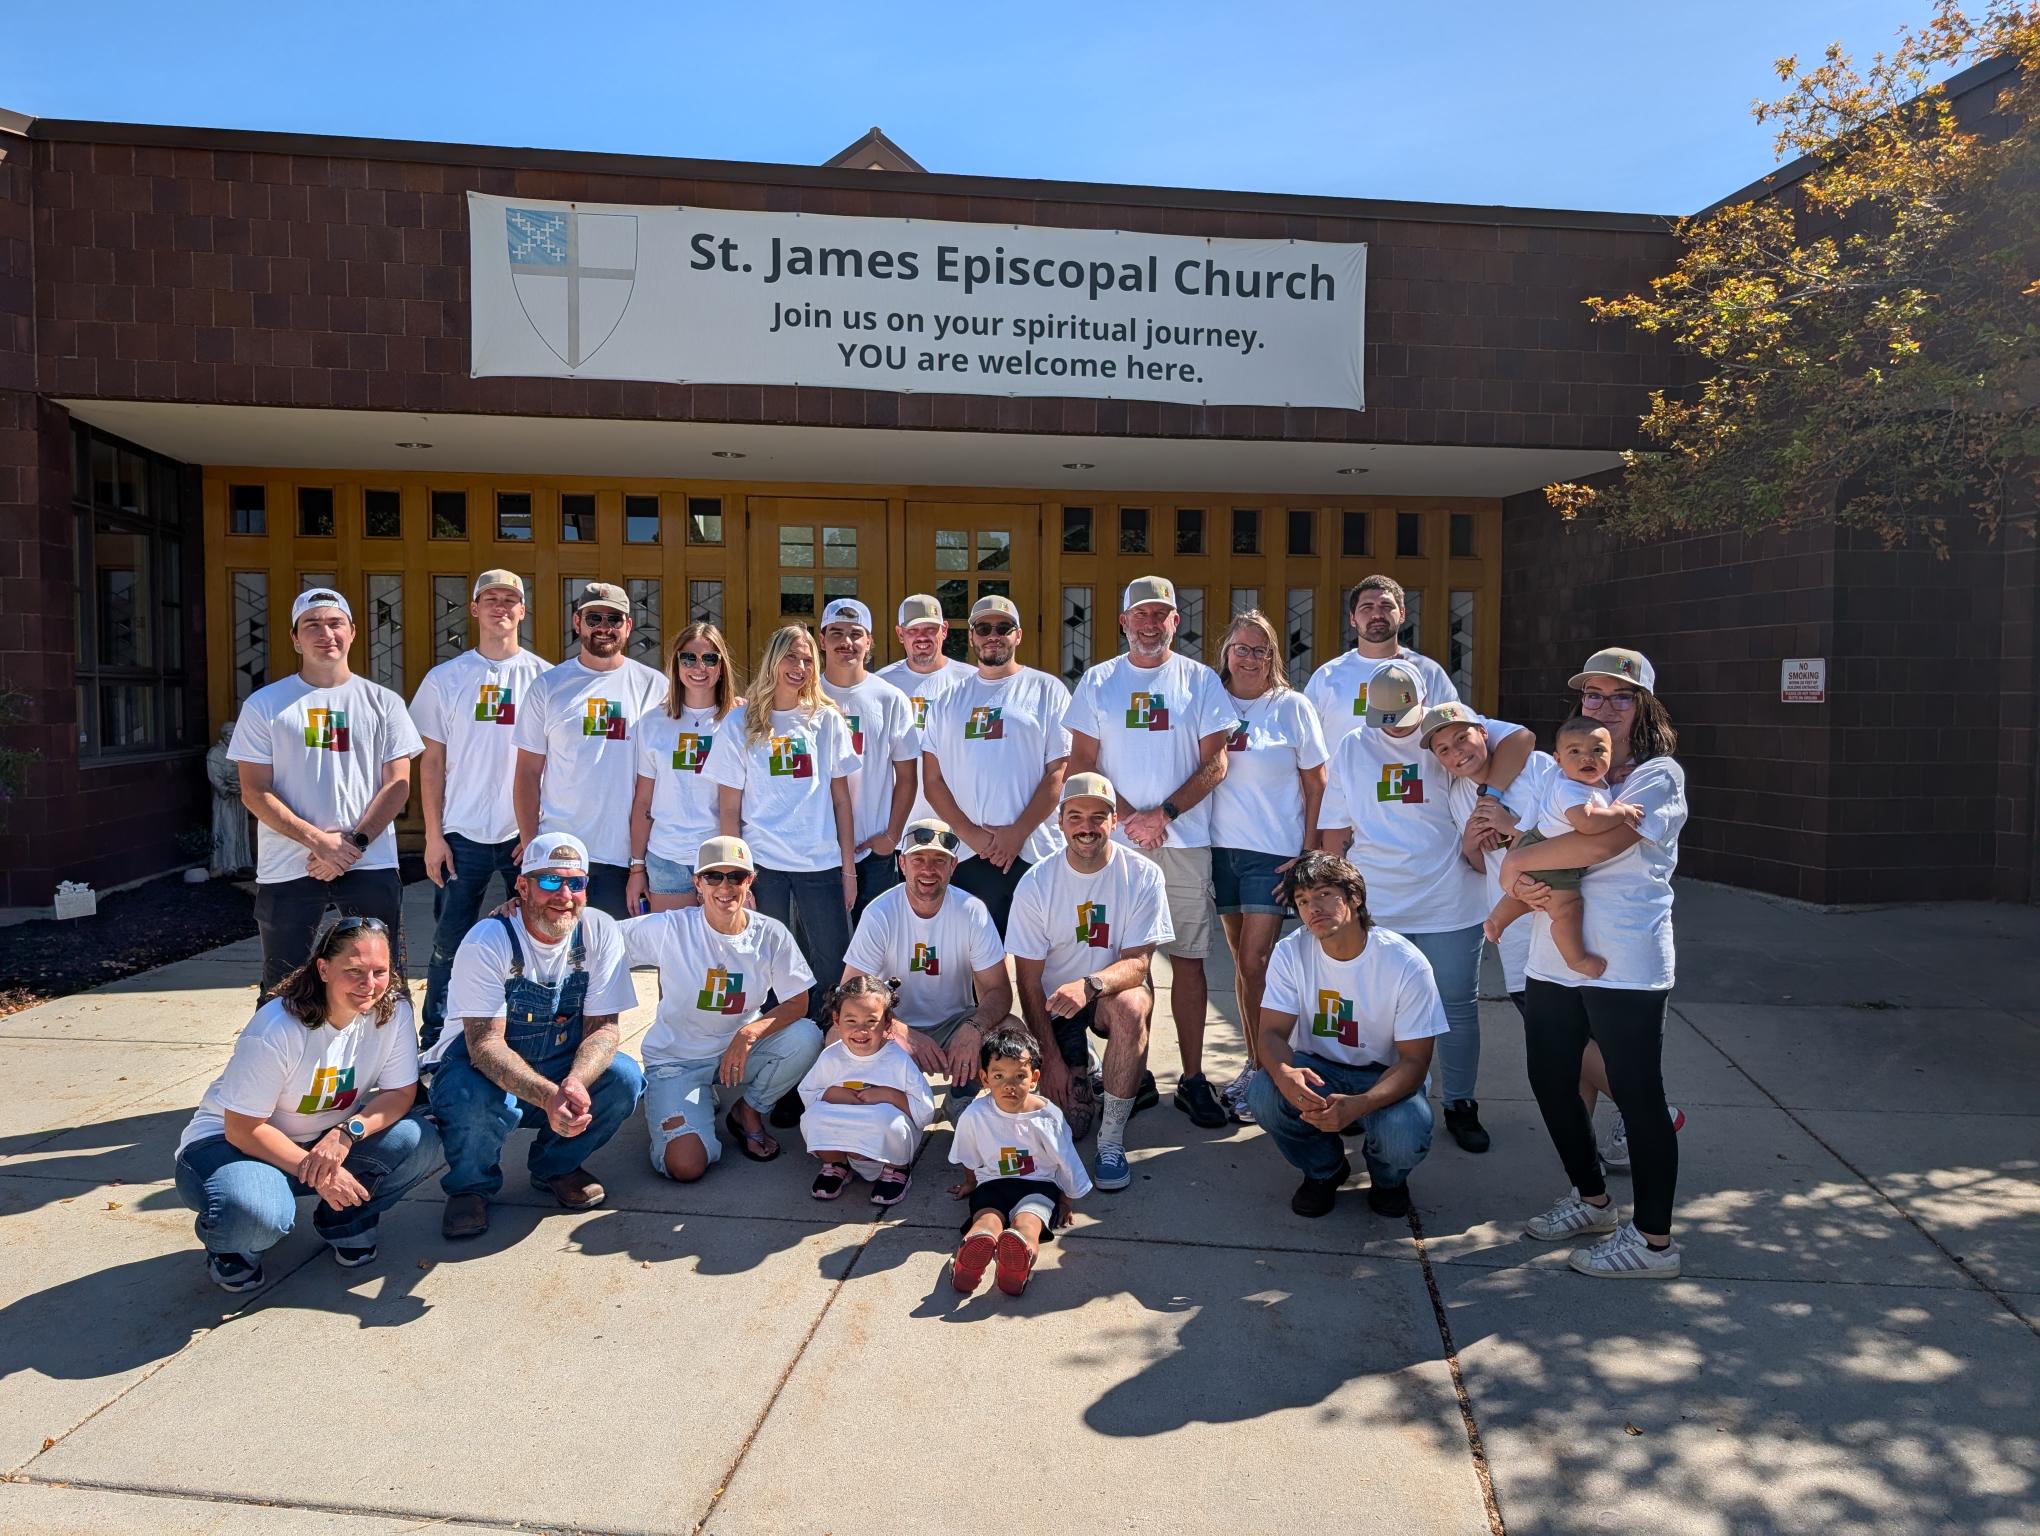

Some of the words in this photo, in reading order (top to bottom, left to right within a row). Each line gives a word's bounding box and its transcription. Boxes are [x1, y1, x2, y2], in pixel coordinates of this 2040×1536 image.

[690, 233, 752, 273] St.
[763, 237, 919, 284] James
[937, 245, 1157, 301] Episcopal
[1174, 255, 1335, 302] Church
[769, 302, 832, 333] Join
[843, 310, 877, 331] us
[886, 312, 924, 333] on
[933, 314, 1004, 341] your
[1012, 313, 1136, 345] spiritual
[1142, 318, 1265, 356] journey.
[837, 342, 906, 370] YOU
[917, 352, 969, 373] are
[977, 349, 1117, 379] welcome
[1127, 354, 1203, 384] here.
[1788, 672, 1819, 680] SMOKING
[1798, 662, 1809, 671] NO
[484, 690, 505, 718] E
[590, 704, 615, 732] E
[1135, 697, 1157, 724] E
[972, 710, 998, 735] E
[682, 739, 705, 766] E
[1386, 767, 1411, 796] E
[707, 976, 735, 1009] E
[1323, 997, 1346, 1034] E
[311, 1073, 348, 1112] E
[1003, 1152, 1025, 1172] E
